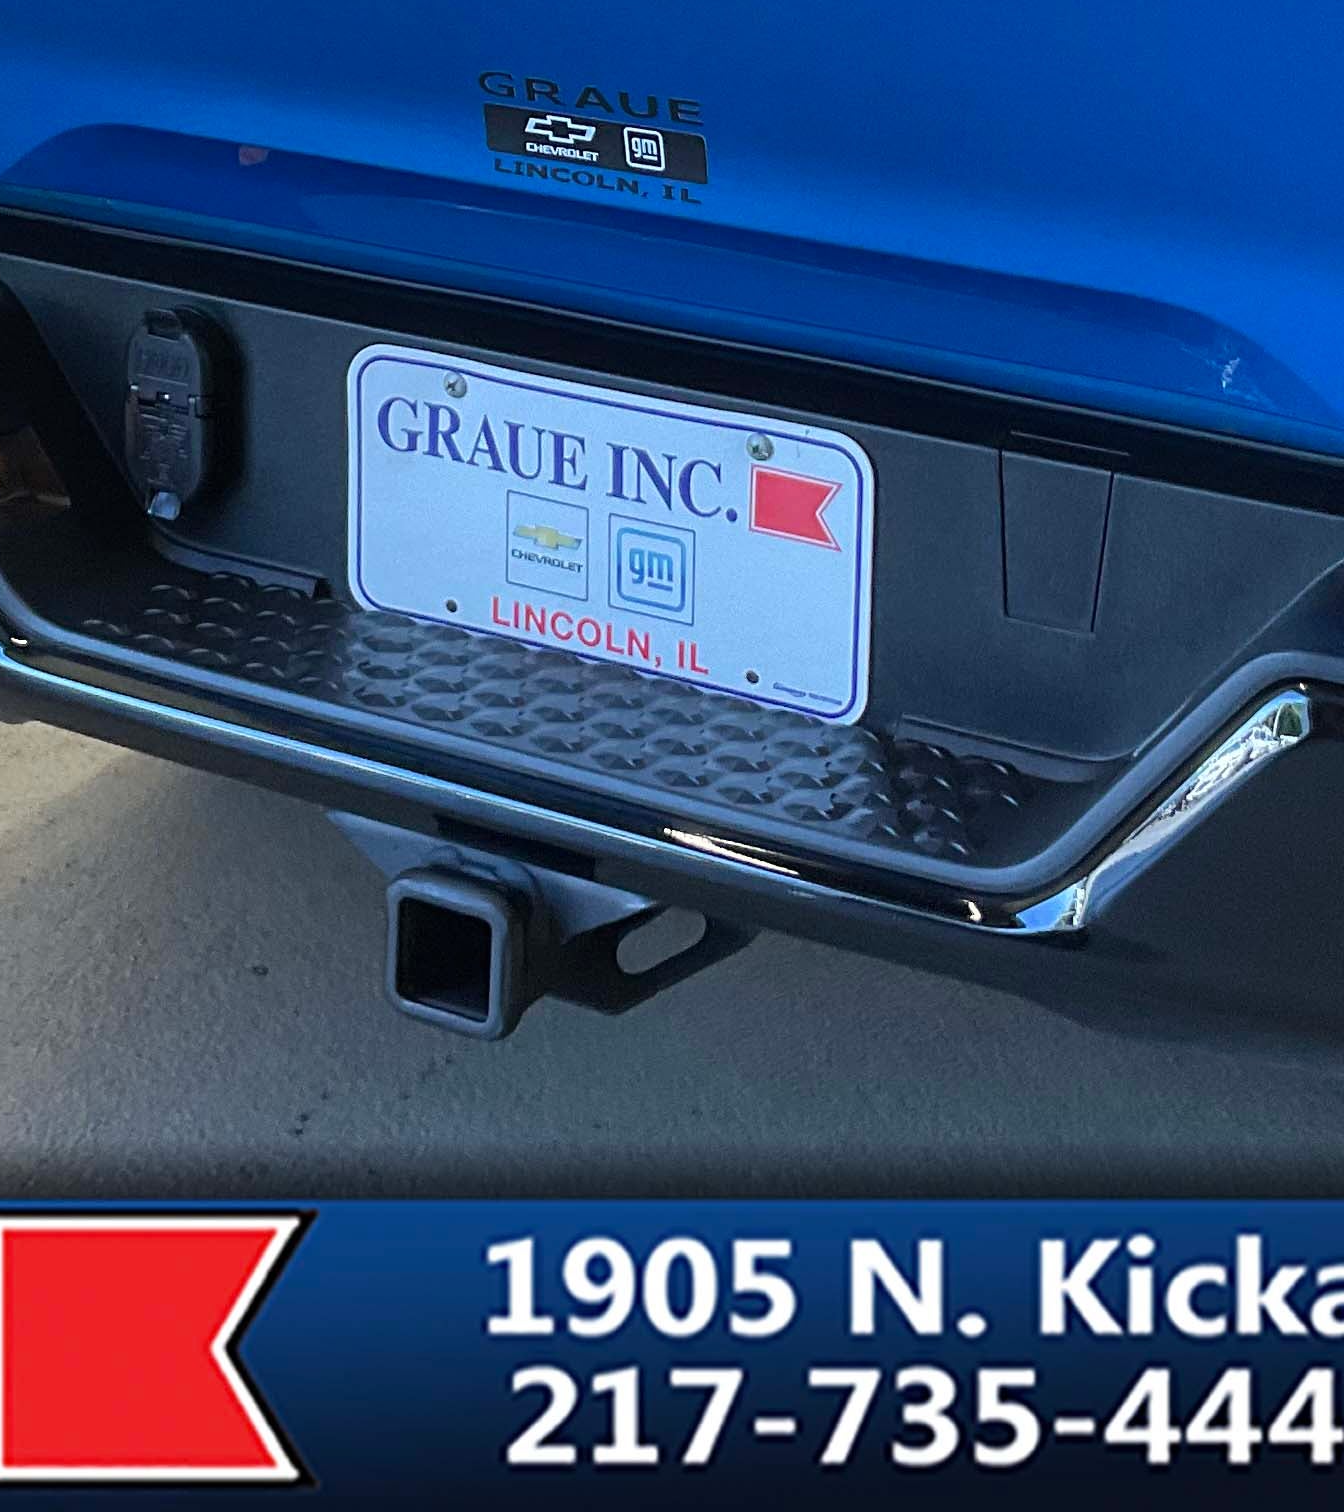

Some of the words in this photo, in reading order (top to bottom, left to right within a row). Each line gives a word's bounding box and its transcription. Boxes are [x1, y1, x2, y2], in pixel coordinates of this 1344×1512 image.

[478, 71, 705, 126] GRAUE
[525, 142, 599, 162] CHEVROLET
[631, 137, 659, 161] gm
[493, 158, 649, 199] LINCOLN,
[663, 184, 702, 205] IL
[377, 396, 588, 491] GRAUE
[605, 442, 739, 523] INC.
[510, 548, 584, 574] CHEVROLET
[628, 548, 674, 591] gm
[490, 596, 663, 668] LINCOLN,
[678, 640, 710, 675] IL
